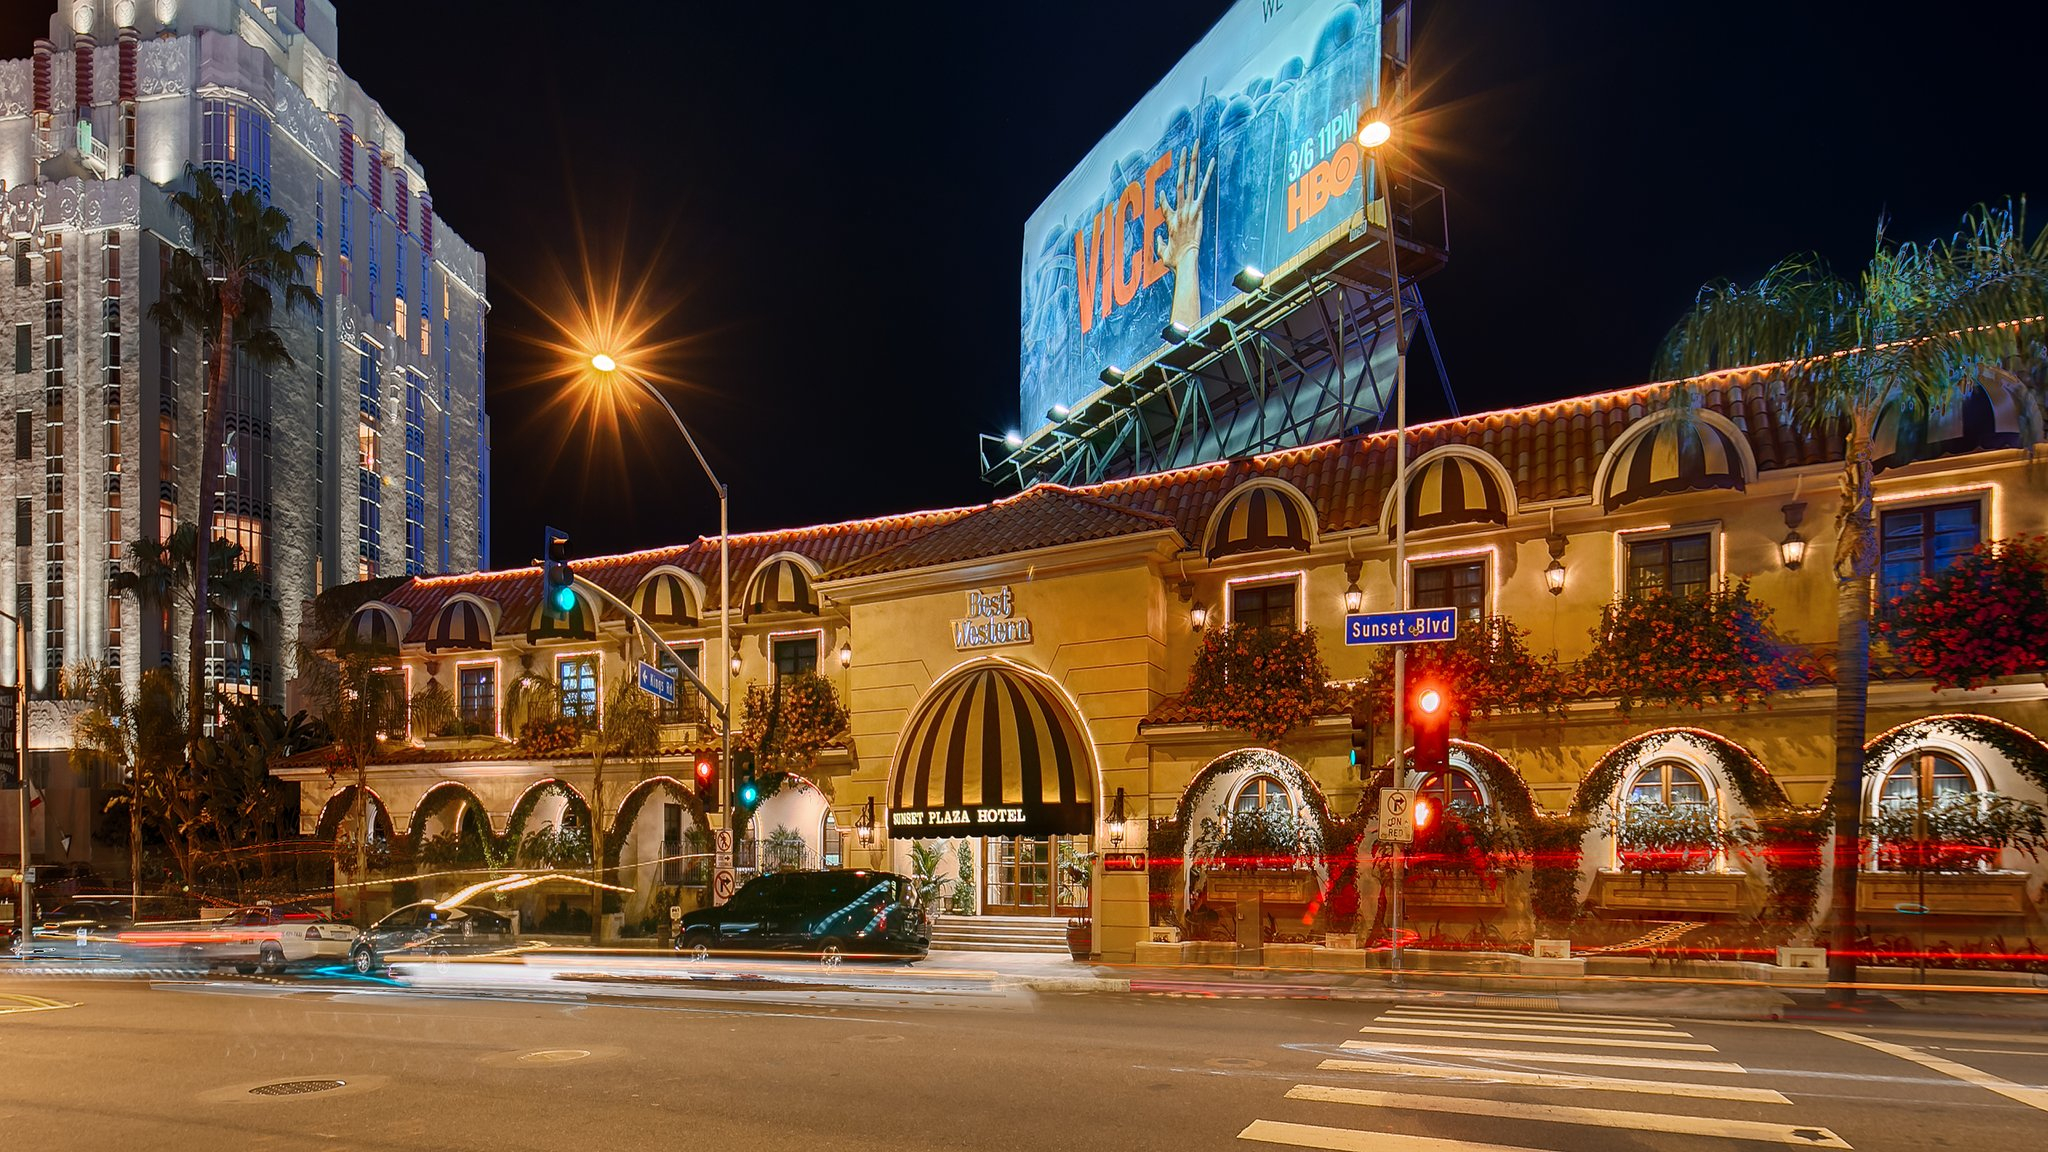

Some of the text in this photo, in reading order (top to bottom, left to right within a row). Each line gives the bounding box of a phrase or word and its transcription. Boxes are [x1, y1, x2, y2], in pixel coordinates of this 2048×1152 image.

[1289, 101, 1358, 182] 3/6 11PM
[1287, 142, 1359, 233] HBO
[1074, 149, 1173, 335] VICE
[968, 587, 1010, 617] Best
[953, 616, 1029, 648] Western
[1352, 615, 1450, 638] Sunset Blvd
[650, 673, 664, 694] Kings
[893, 808, 1026, 826] SUNSET PLAZA HOTEL
[1388, 828, 1404, 838] RED
